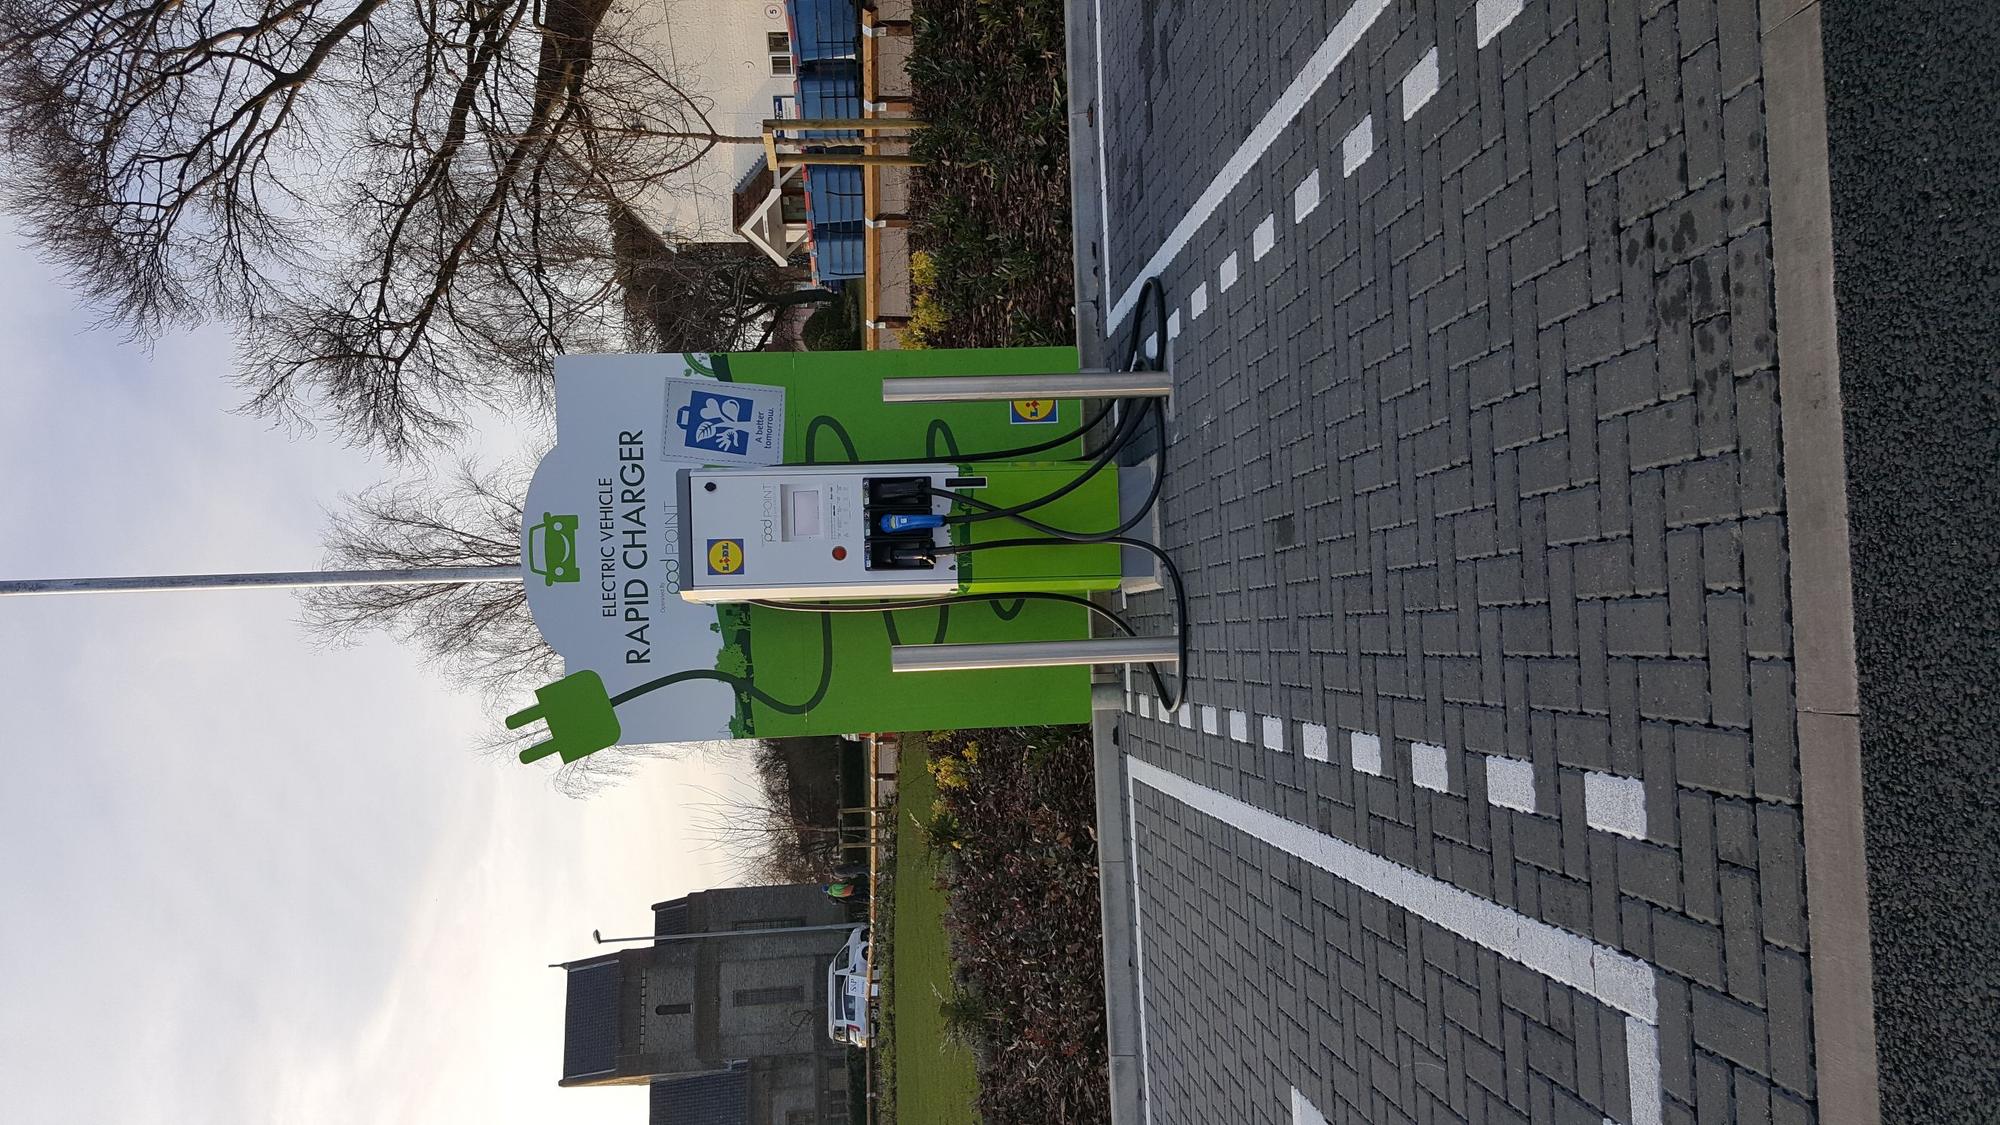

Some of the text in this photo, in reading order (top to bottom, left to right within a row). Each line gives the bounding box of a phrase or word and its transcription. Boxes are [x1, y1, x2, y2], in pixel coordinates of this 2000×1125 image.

[755, 411, 765, 444] A better
[764, 408, 774, 449] tomorrow.
[763, 483, 773, 517] POINT
[598, 477, 617, 617] ELECTRIC VEHICLE
[618, 430, 651, 664] RAPID CHARGER
[663, 501, 679, 554] POINT
